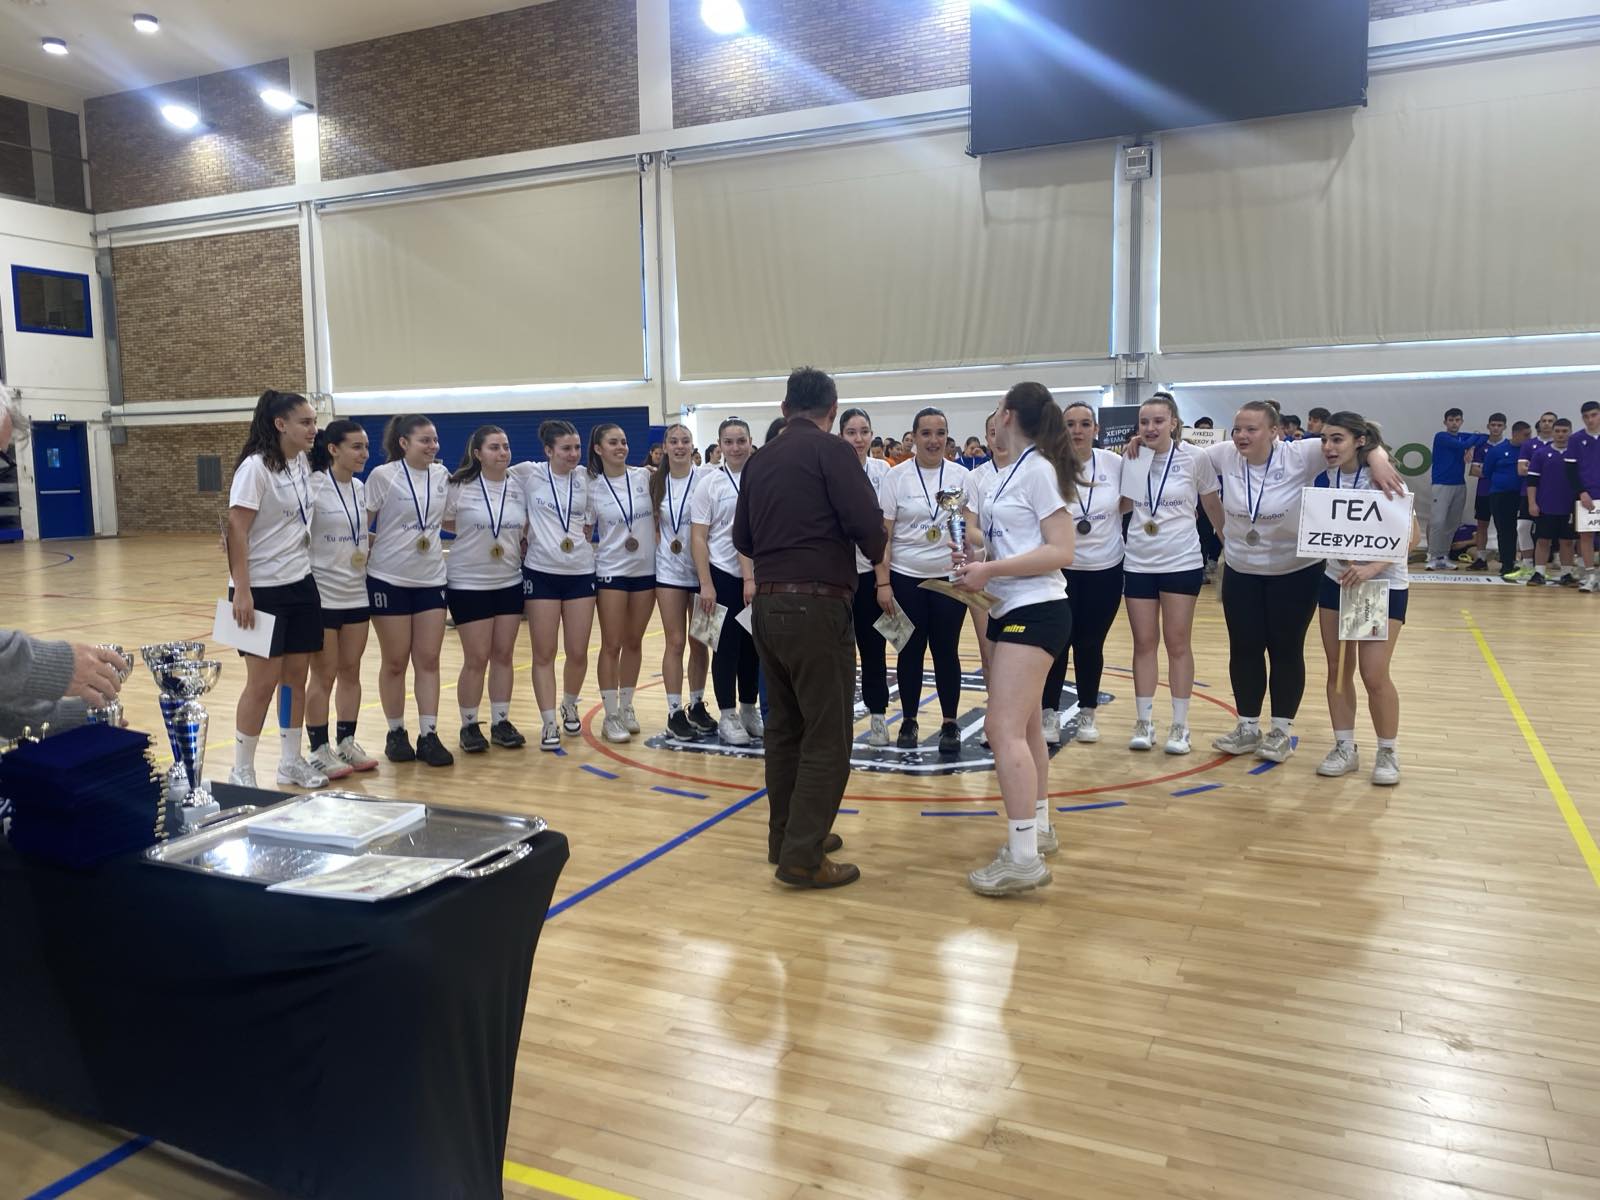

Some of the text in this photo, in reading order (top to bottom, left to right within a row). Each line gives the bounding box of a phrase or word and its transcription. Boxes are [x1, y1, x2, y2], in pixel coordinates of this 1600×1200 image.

[1331, 499, 1383, 522] ΓΕΛ
[1308, 532, 1401, 550] ΖΕΦΥΡΙΟΥ
[373, 591, 388, 609] 81
